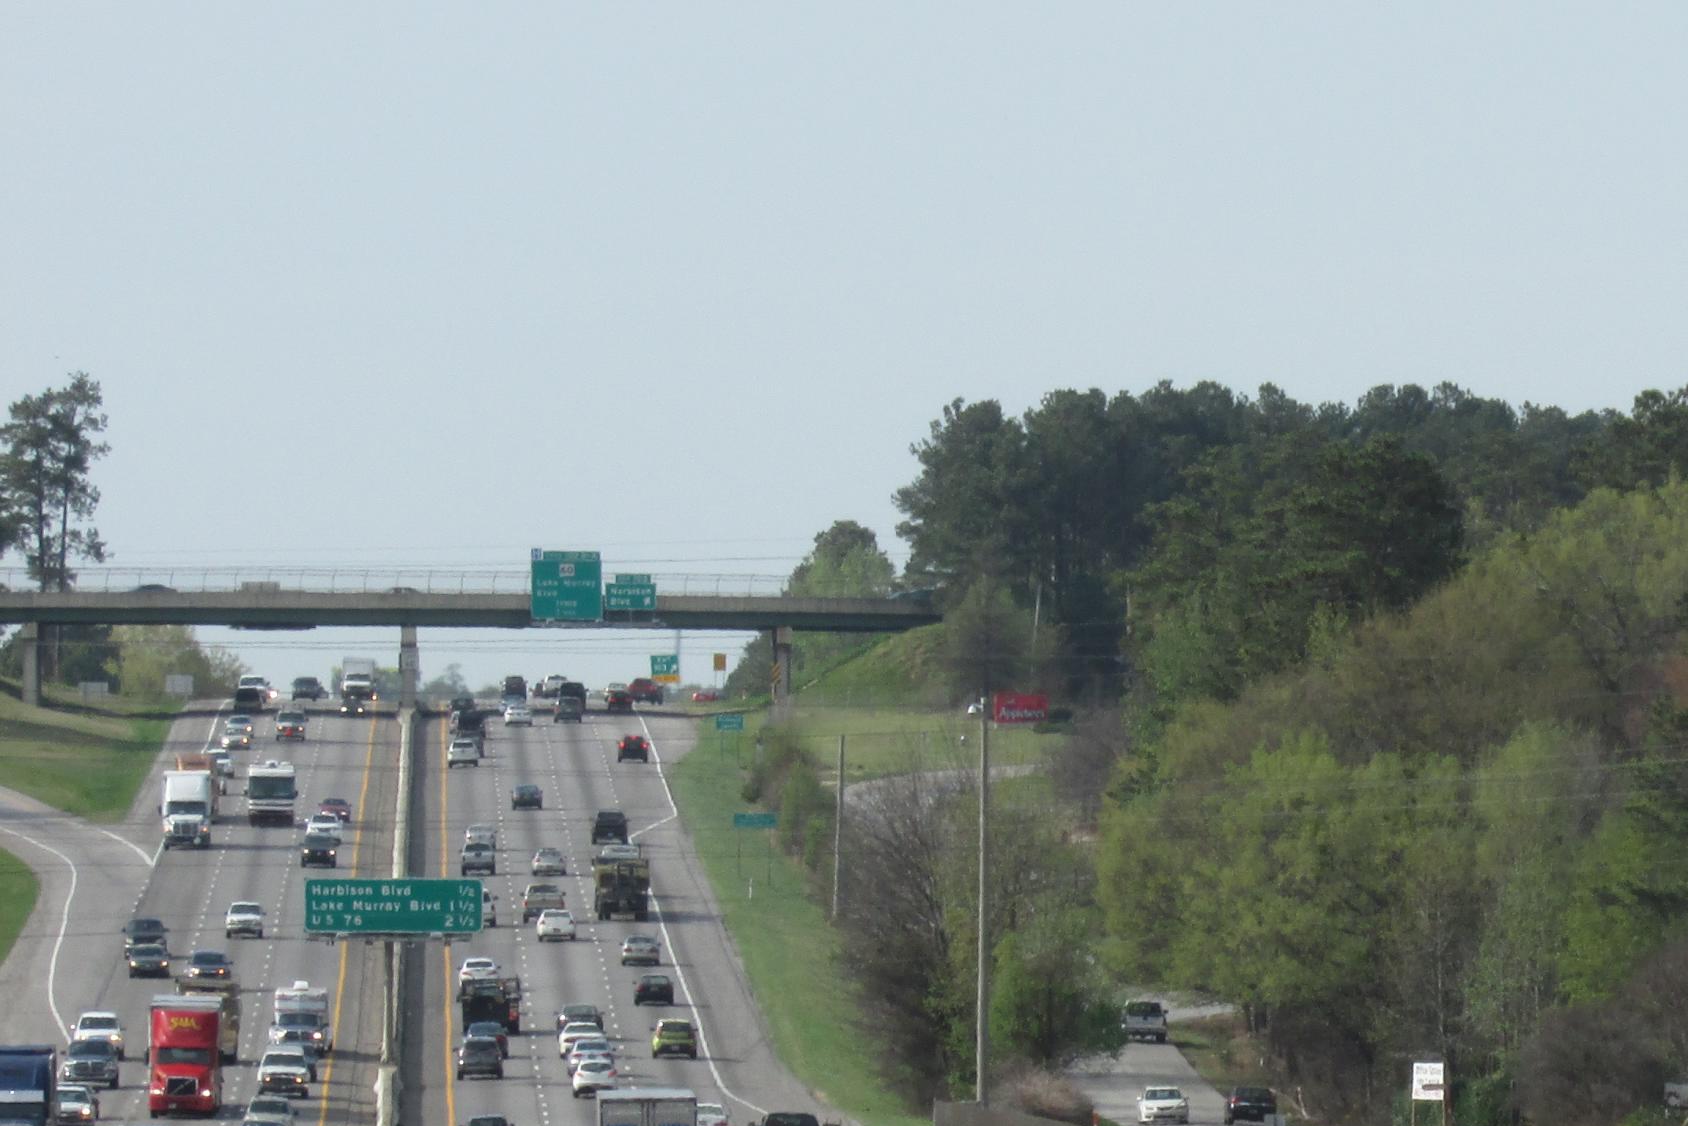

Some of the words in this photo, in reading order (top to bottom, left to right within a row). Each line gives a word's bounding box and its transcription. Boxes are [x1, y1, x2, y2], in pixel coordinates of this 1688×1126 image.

[312, 885, 373, 896] Harbison
[381, 885, 412, 896] Blvd
[312, 901, 344, 911] Lake
[353, 901, 401, 912] Murray
[410, 901, 441, 911] Blvd
[344, 915, 363, 926] 76
